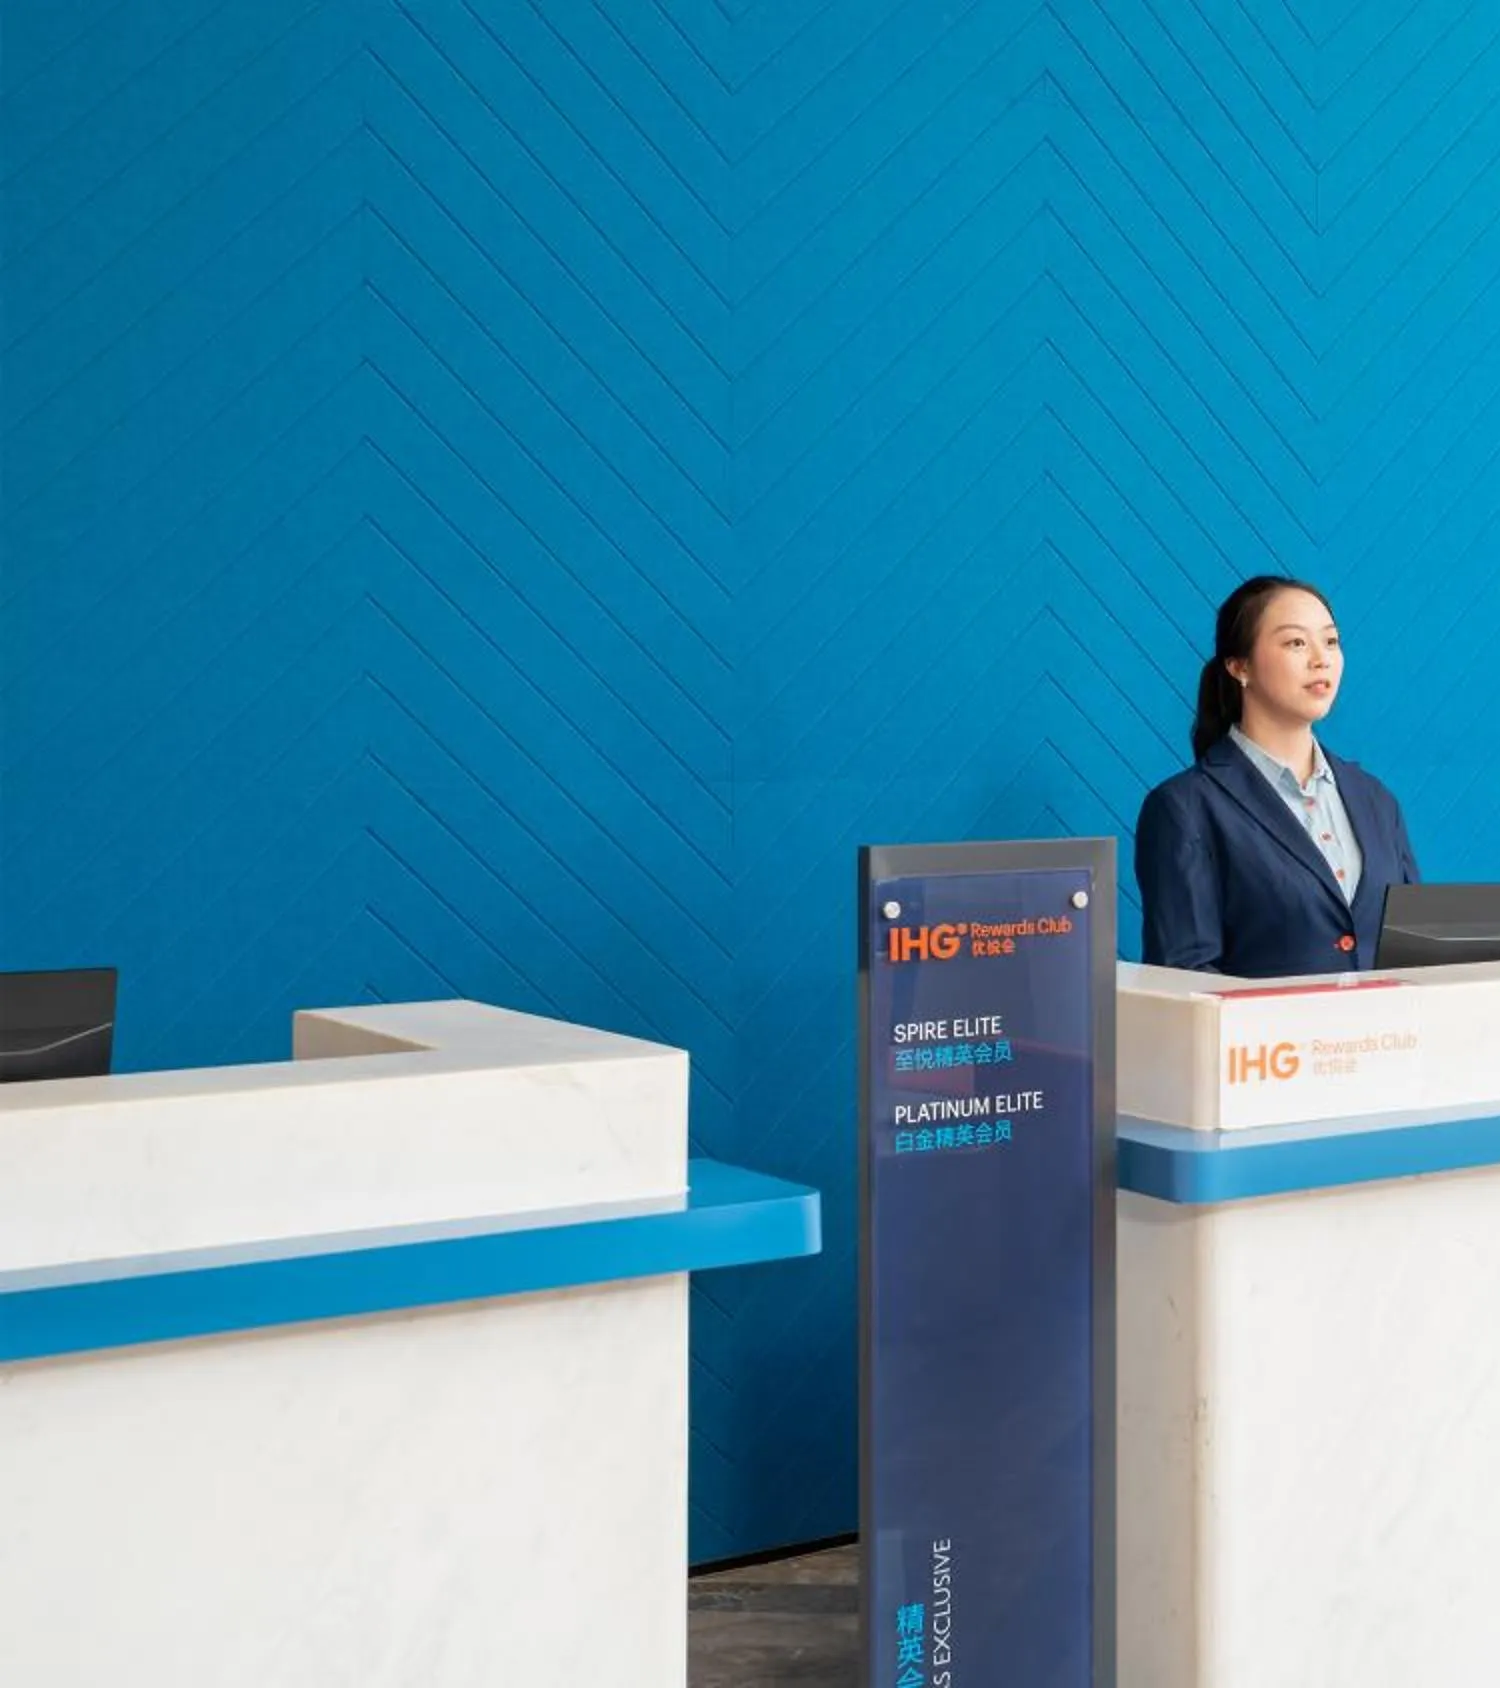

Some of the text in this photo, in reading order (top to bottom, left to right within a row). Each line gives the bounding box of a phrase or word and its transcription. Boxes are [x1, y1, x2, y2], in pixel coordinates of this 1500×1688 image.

[971, 918, 1035, 938] Rewards
[1038, 915, 1073, 934] Club
[894, 1016, 1003, 1043] SPIRE ELITE
[895, 1038, 1013, 1071] 至悦精英会员
[1228, 1041, 1300, 1085] IHG
[1380, 1031, 1417, 1051] Club
[895, 1091, 1043, 1125] PLATINUM ELITE
[895, 1119, 1013, 1154] 白金精英会员
[933, 1537, 951, 1666] EXCLUSIVE
